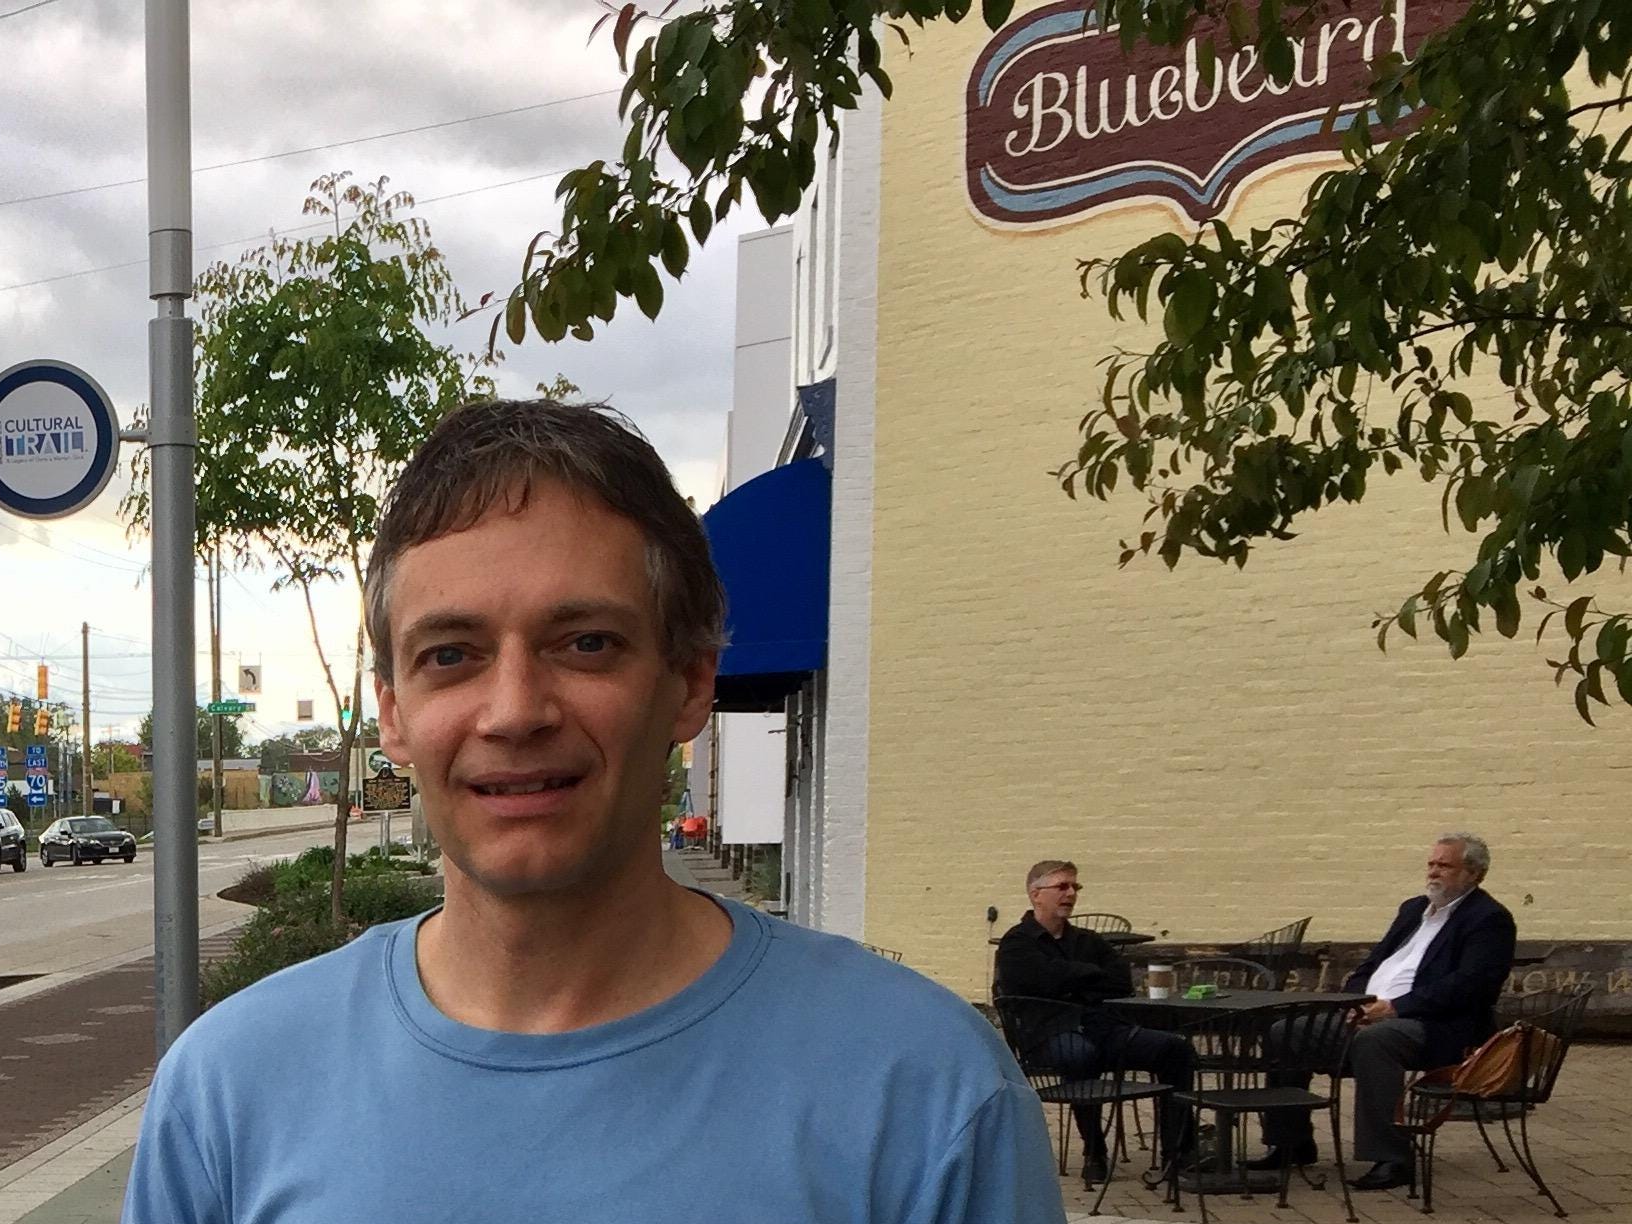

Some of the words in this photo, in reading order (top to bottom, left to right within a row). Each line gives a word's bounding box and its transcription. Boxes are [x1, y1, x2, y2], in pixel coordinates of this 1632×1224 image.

[5, 416, 83, 433] CULTURAL
[5, 431, 84, 457] TRAIL
[27, 758, 45, 767] EAST
[28, 775, 46, 787] 70
